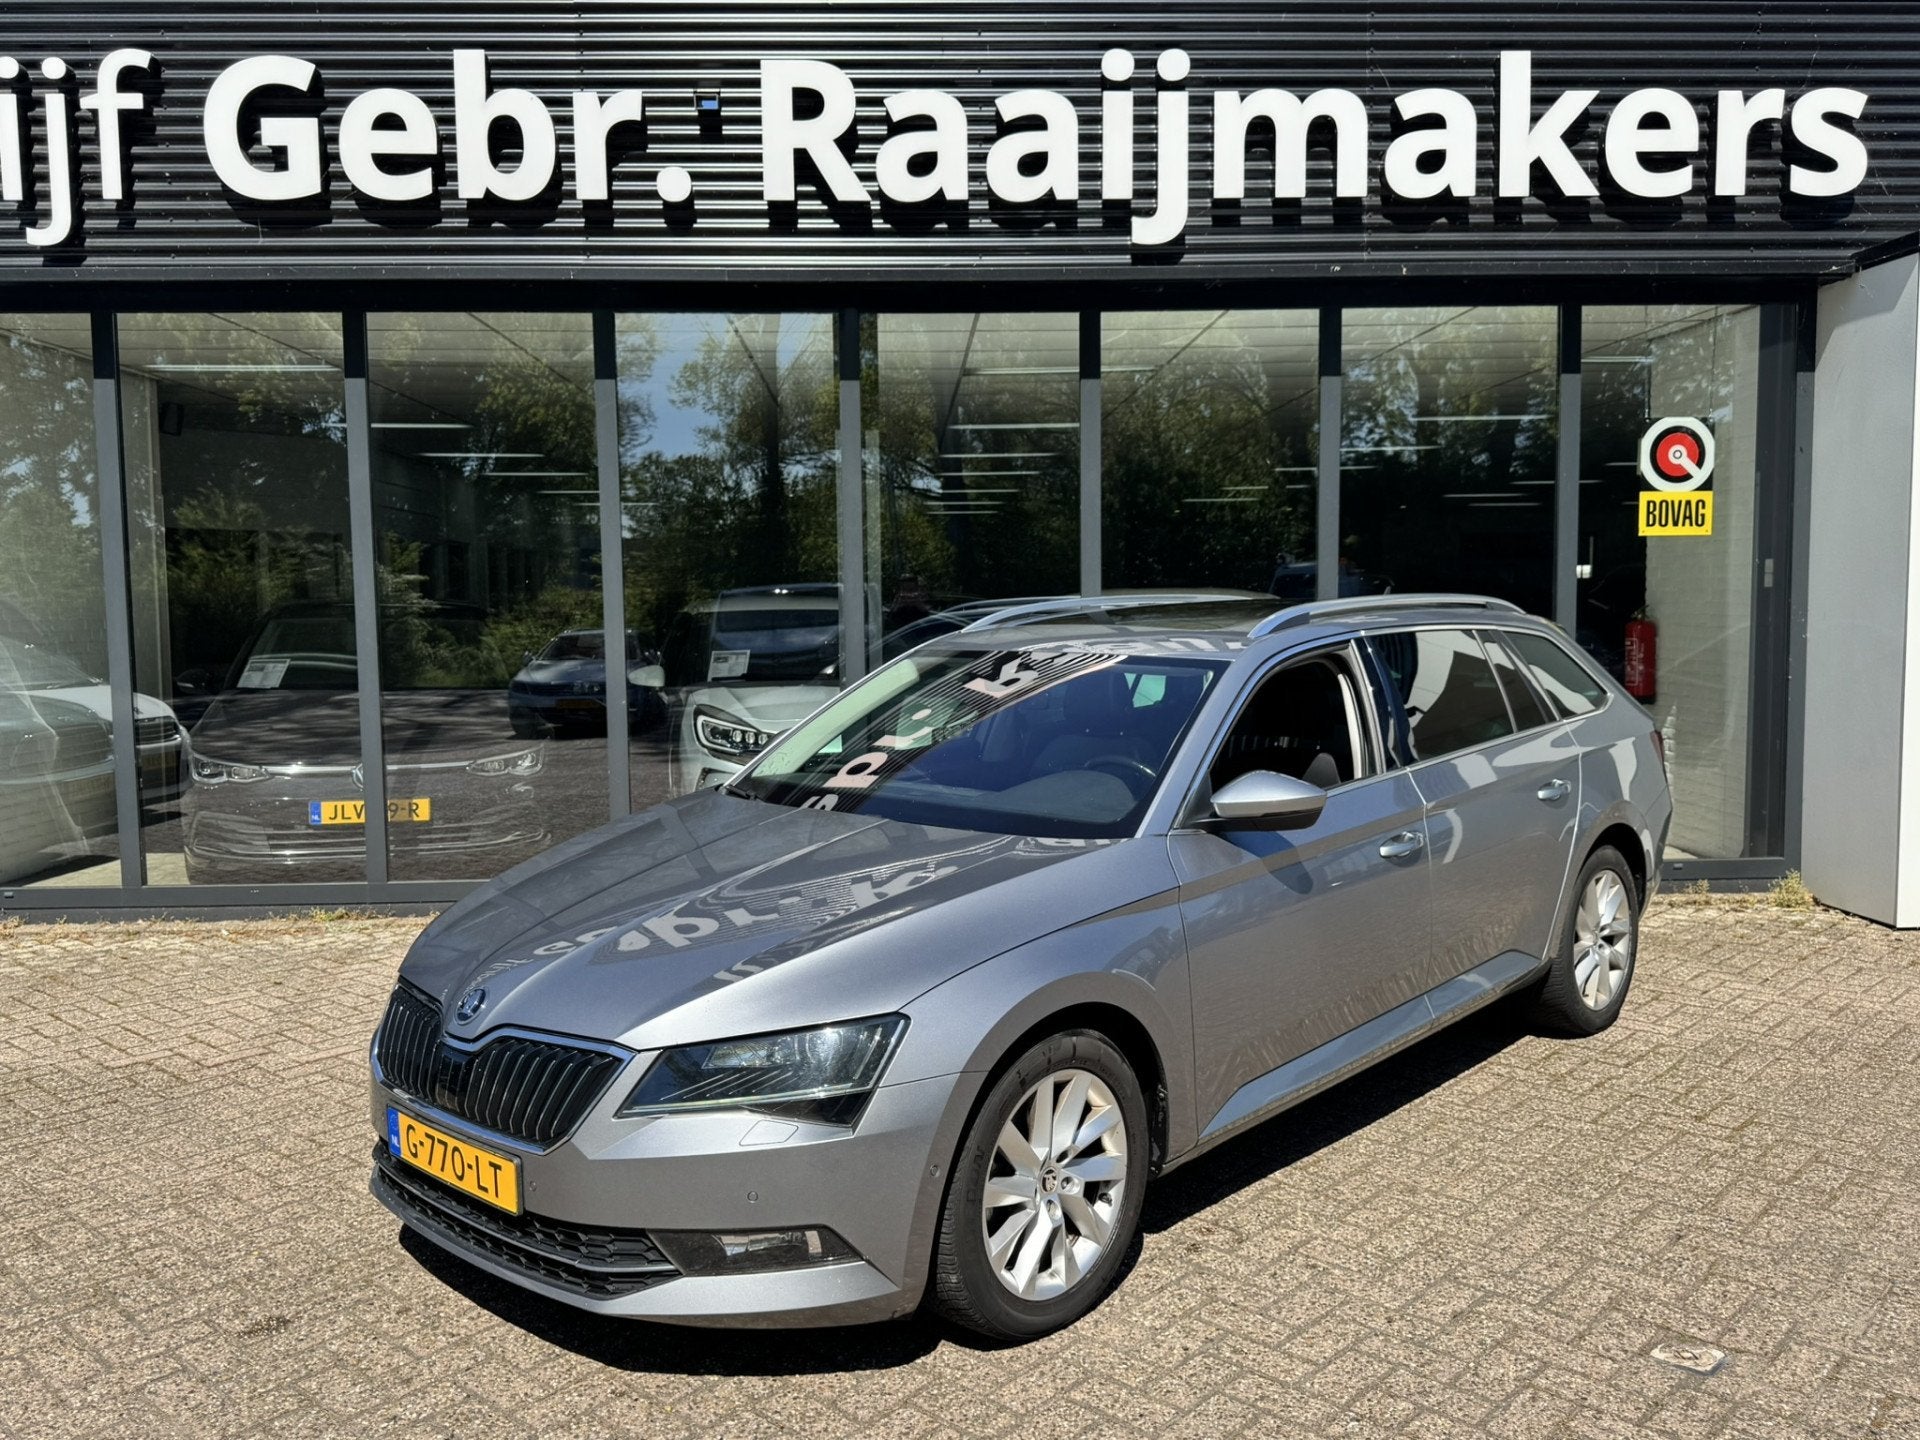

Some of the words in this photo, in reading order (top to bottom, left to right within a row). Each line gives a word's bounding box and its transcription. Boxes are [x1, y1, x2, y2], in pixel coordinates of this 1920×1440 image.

[203, 49, 693, 203] Gebr.
[760, 48, 1869, 246] Raaijmakers
[1645, 499, 1706, 528] BOVAG
[391, 1134, 400, 1147] NL
[405, 1123, 503, 1199] G-770-LT
